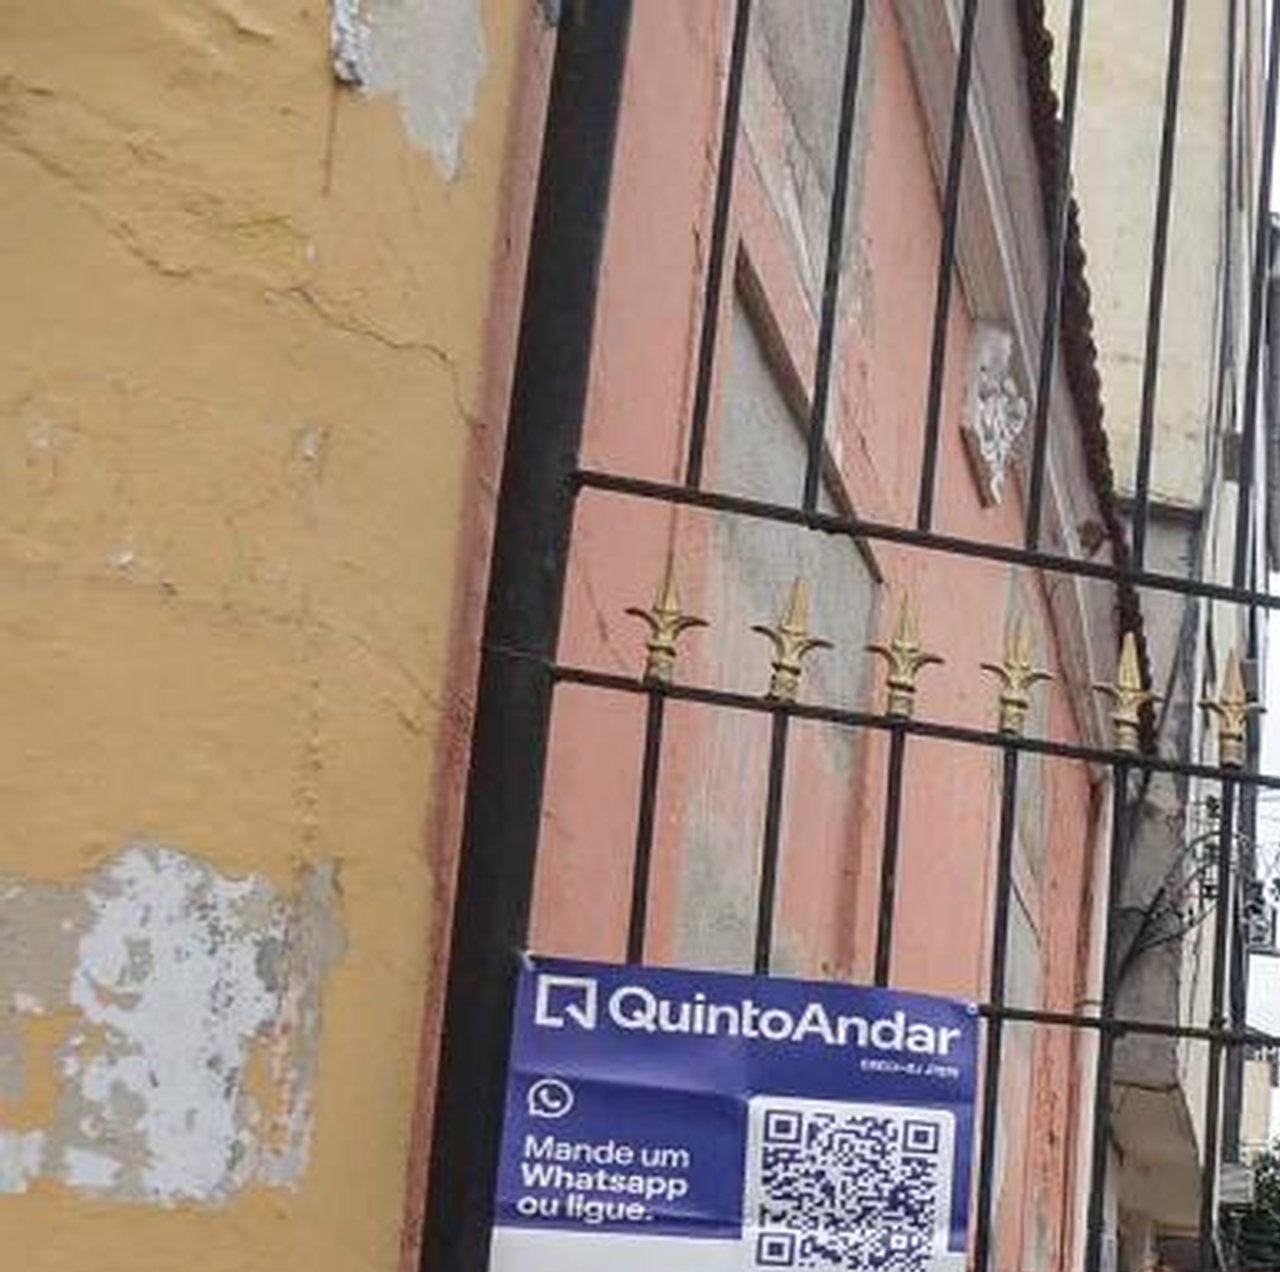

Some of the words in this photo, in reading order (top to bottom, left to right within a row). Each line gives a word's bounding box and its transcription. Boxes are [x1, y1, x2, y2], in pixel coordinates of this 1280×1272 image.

[608, 985, 961, 1056] QuintoAndar
[525, 1134, 635, 1166] Mande
[641, 1147, 690, 1168] um
[520, 1161, 689, 1201] Whatsapp
[516, 1194, 559, 1217] ou
[565, 1192, 653, 1224] ligue.
